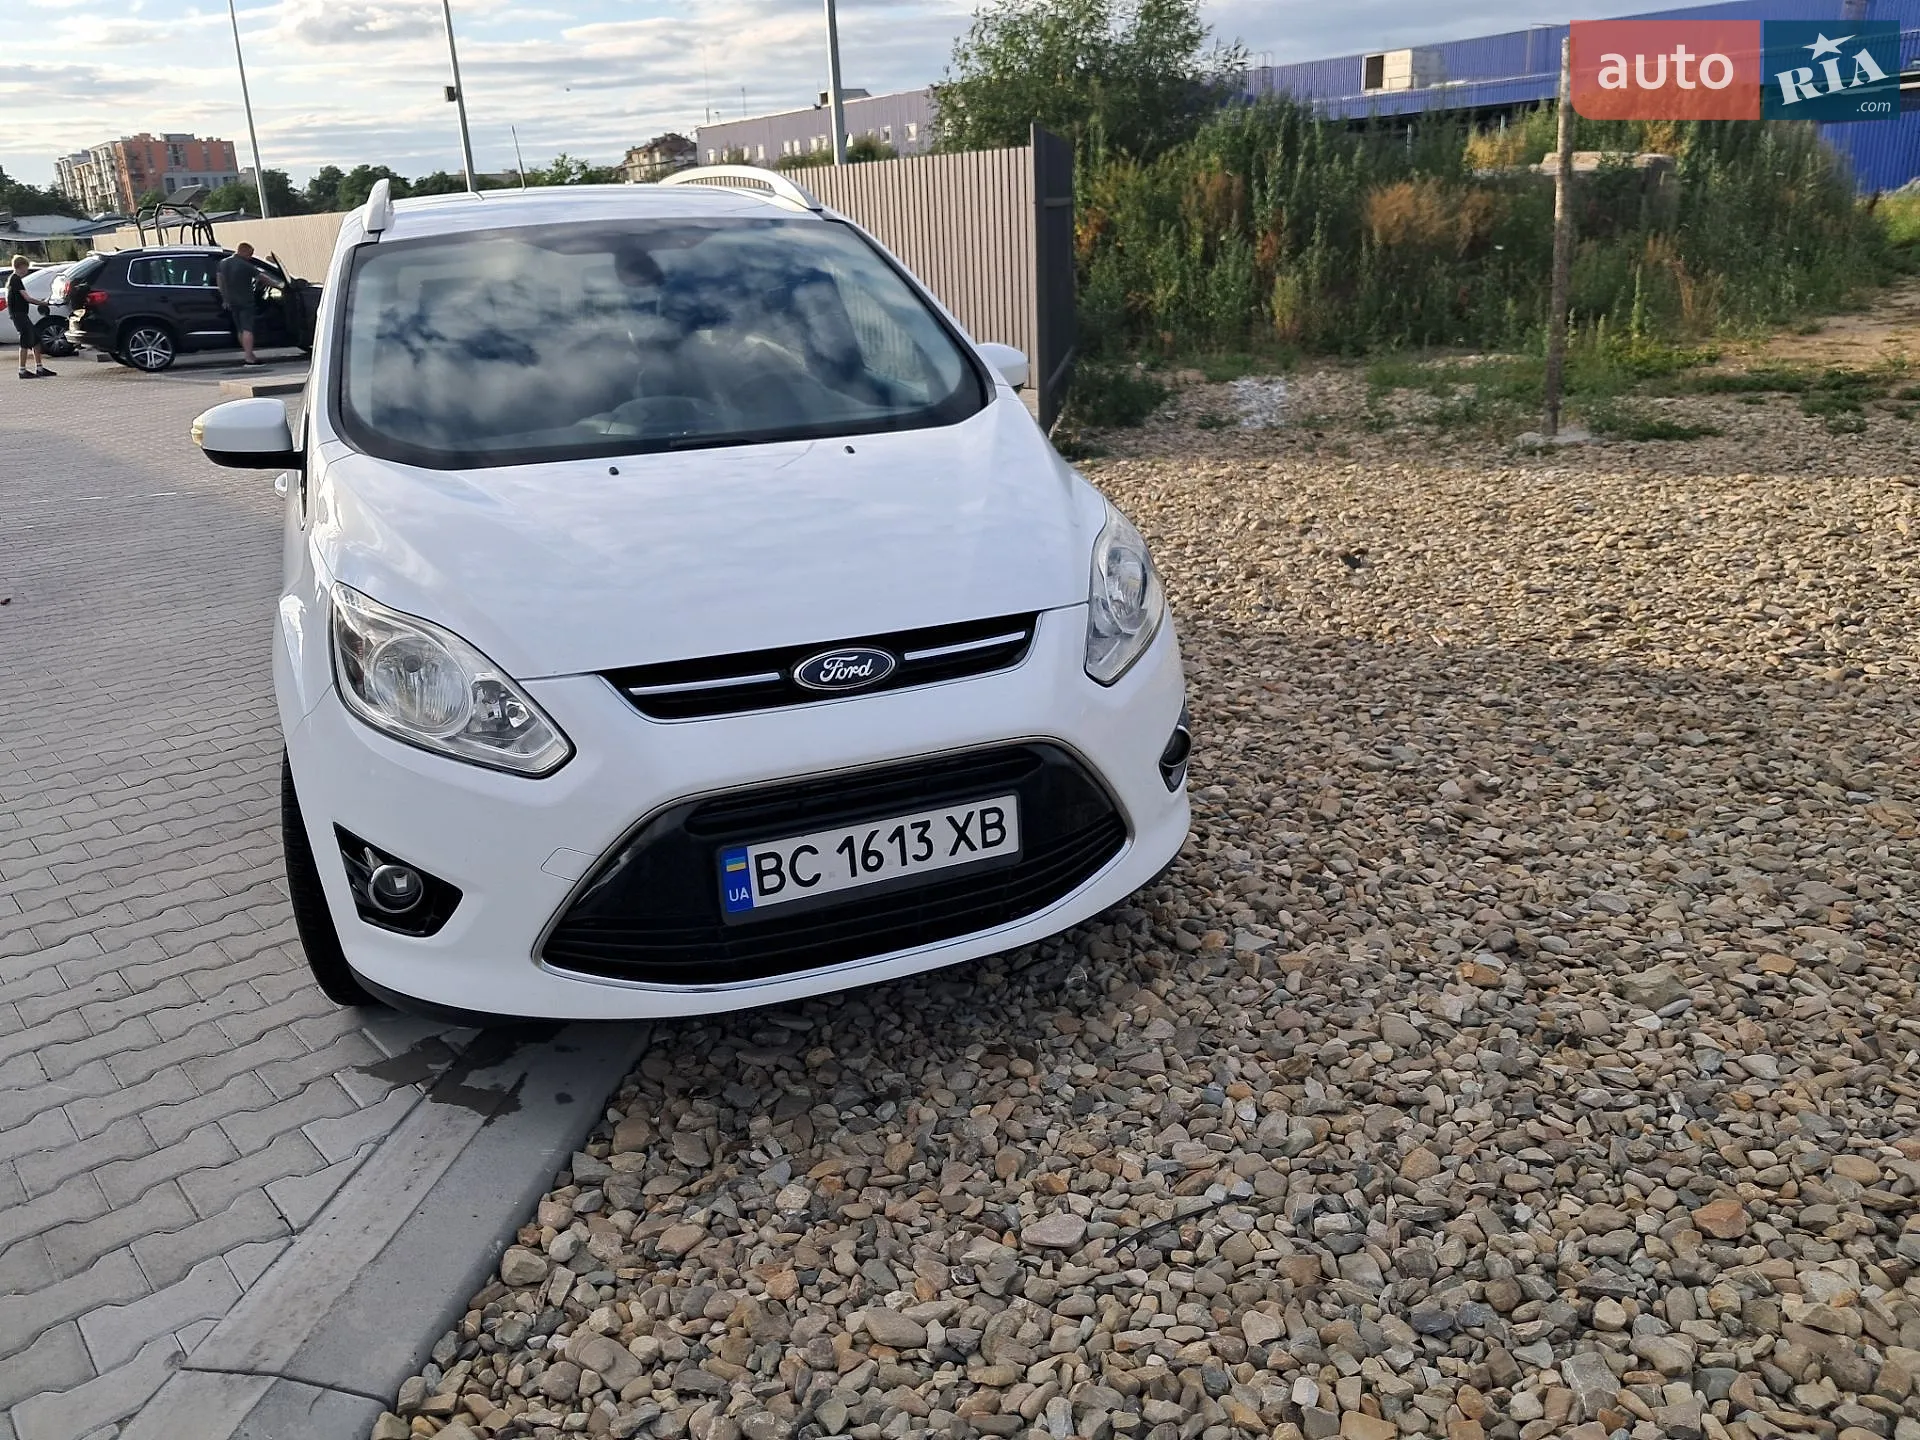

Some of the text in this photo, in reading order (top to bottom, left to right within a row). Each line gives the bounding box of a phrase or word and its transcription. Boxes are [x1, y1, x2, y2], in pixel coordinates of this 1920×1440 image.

[819, 655, 874, 682] Ford
[754, 806, 1007, 897] BC 1613 XB
[728, 886, 750, 902] UA
